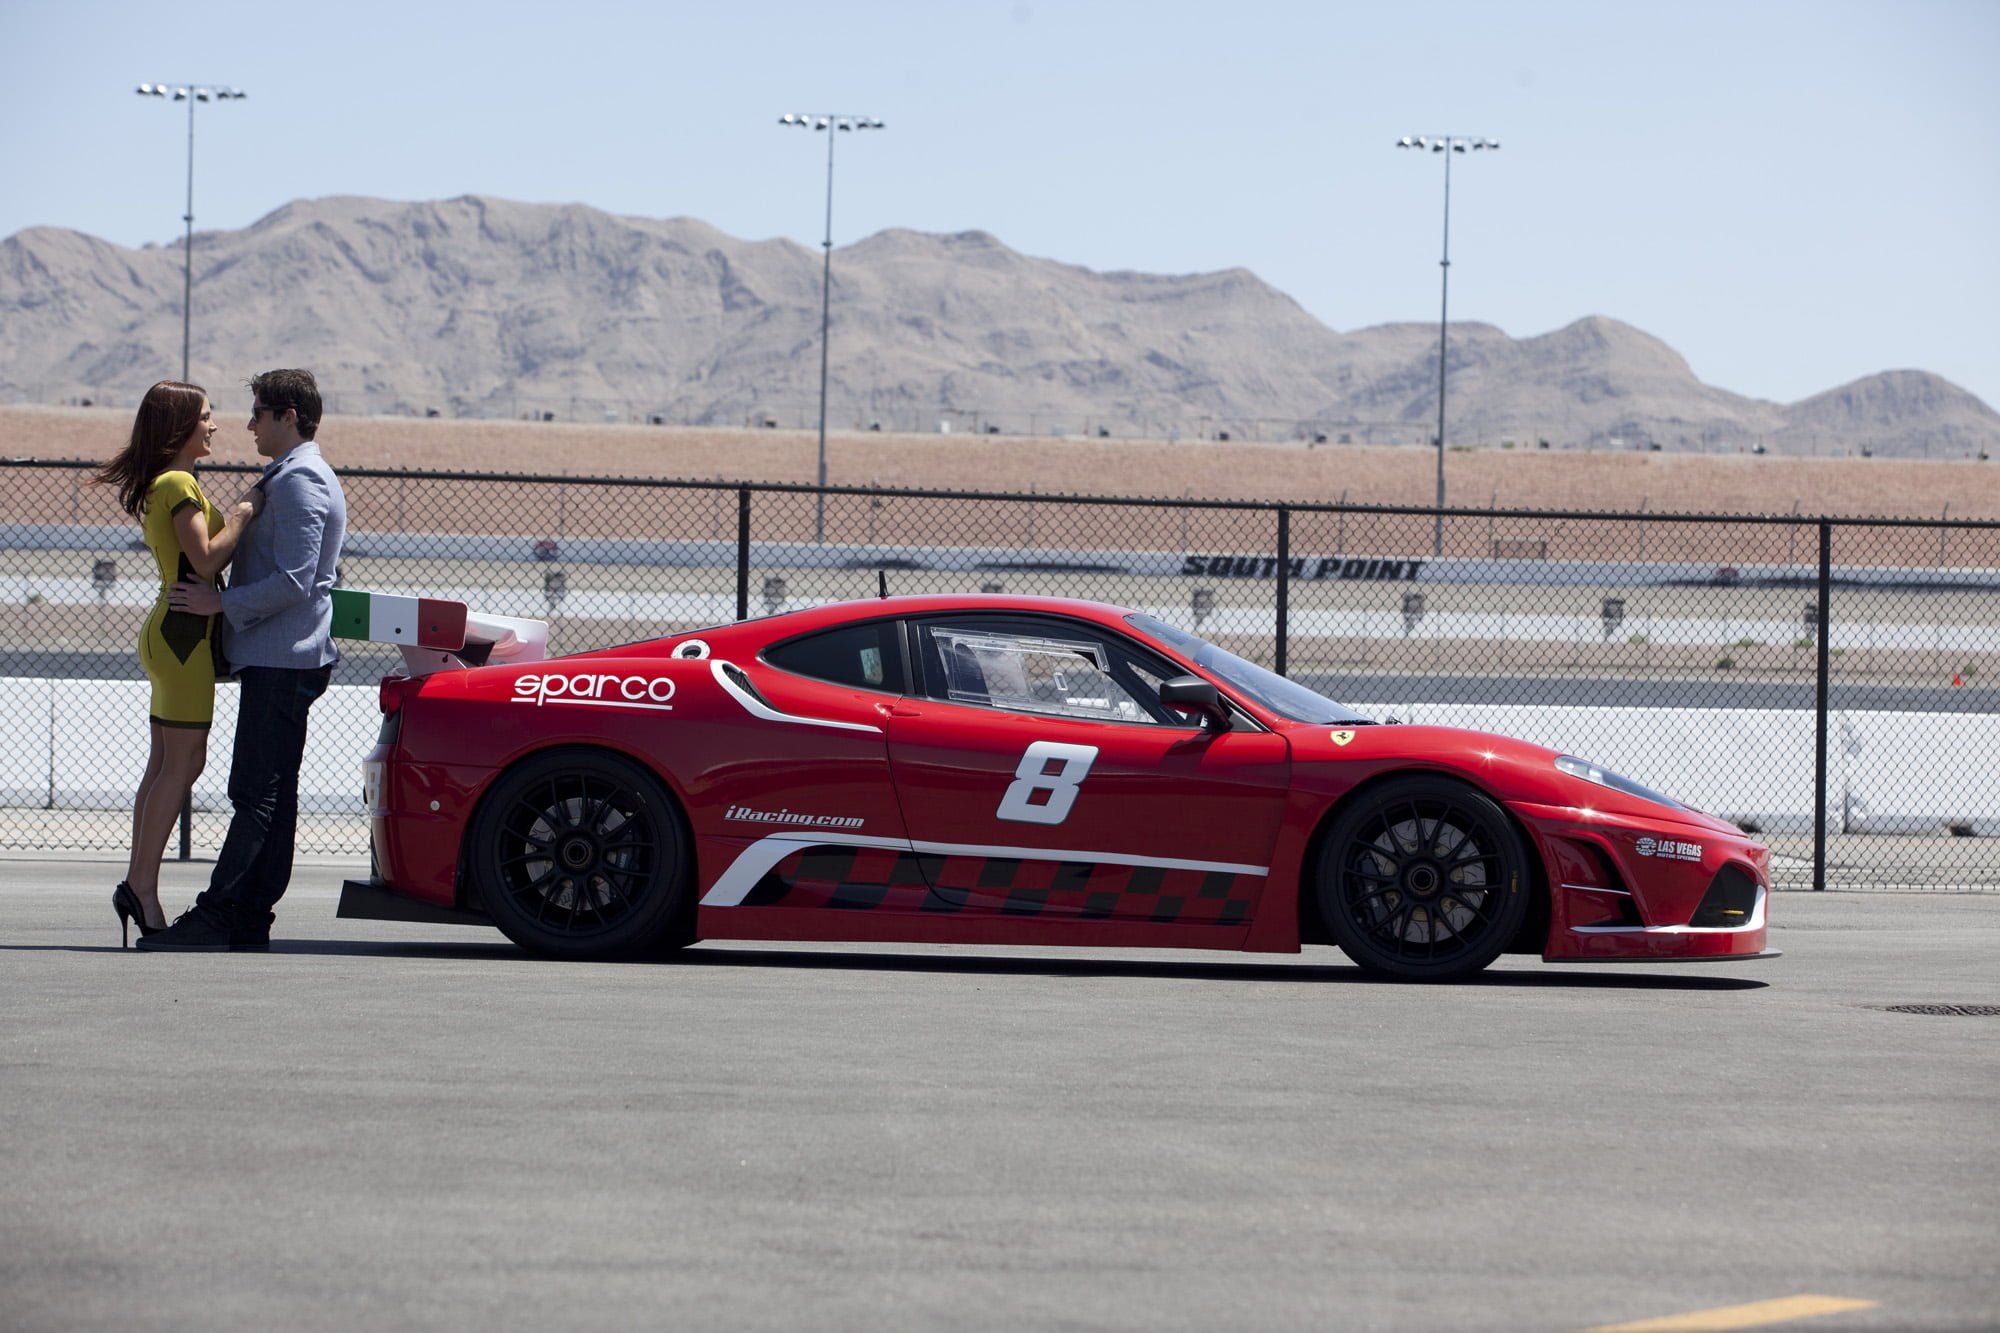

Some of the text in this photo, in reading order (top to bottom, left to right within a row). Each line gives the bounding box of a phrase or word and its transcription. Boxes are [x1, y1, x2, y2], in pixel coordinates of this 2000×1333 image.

[1183, 556, 1425, 580] SOUTH POINT
[513, 674, 676, 707] sparco
[996, 740, 1100, 825] 8
[725, 804, 865, 828] iRacing.com
[1657, 840, 1702, 857] LAS VEGAS
